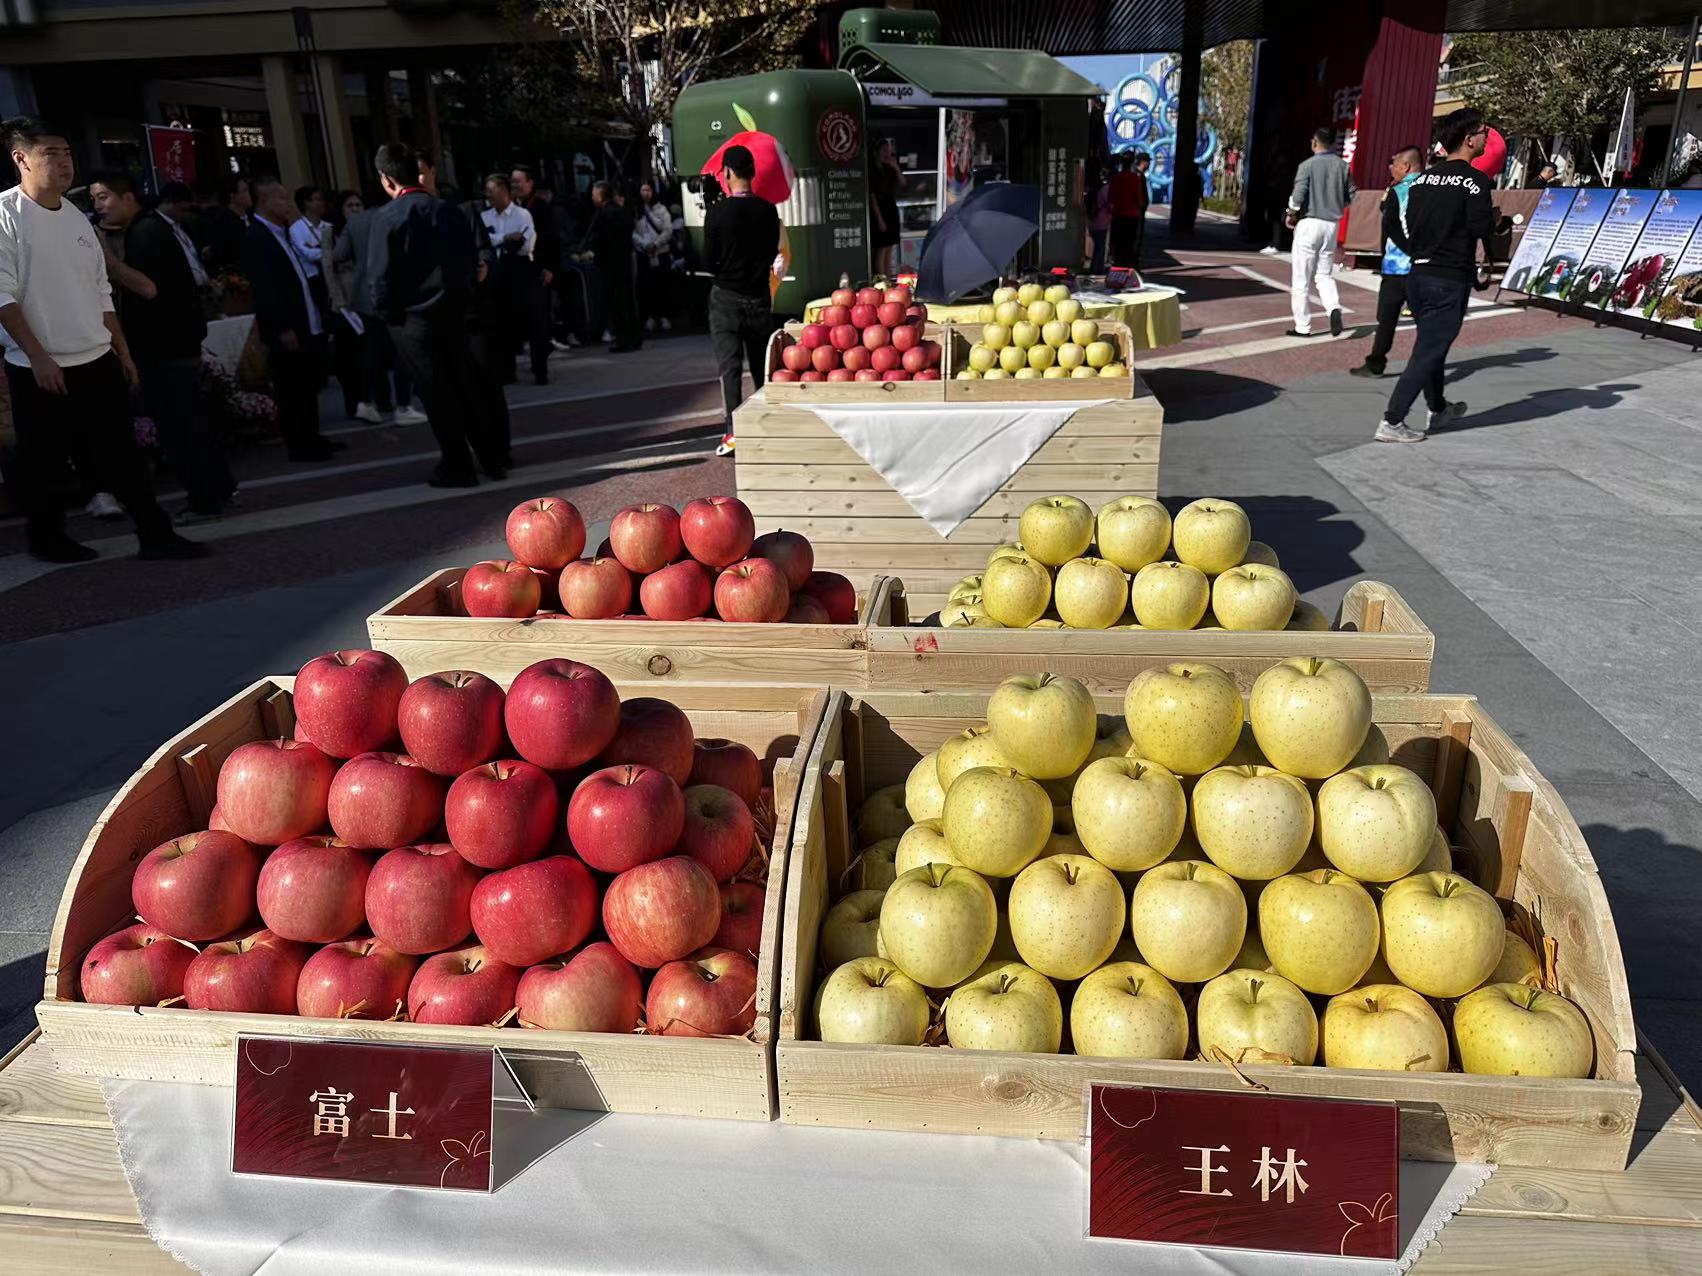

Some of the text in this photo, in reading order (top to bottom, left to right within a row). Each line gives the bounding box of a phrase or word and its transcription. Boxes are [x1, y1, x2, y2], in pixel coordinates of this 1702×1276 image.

[1426, 174, 1441, 186] R8
[1440, 175, 1464, 186] LMS
[1463, 177, 1481, 195] Cup
[308, 1086, 416, 1141] 富士
[1178, 1143, 1310, 1204] 王林
